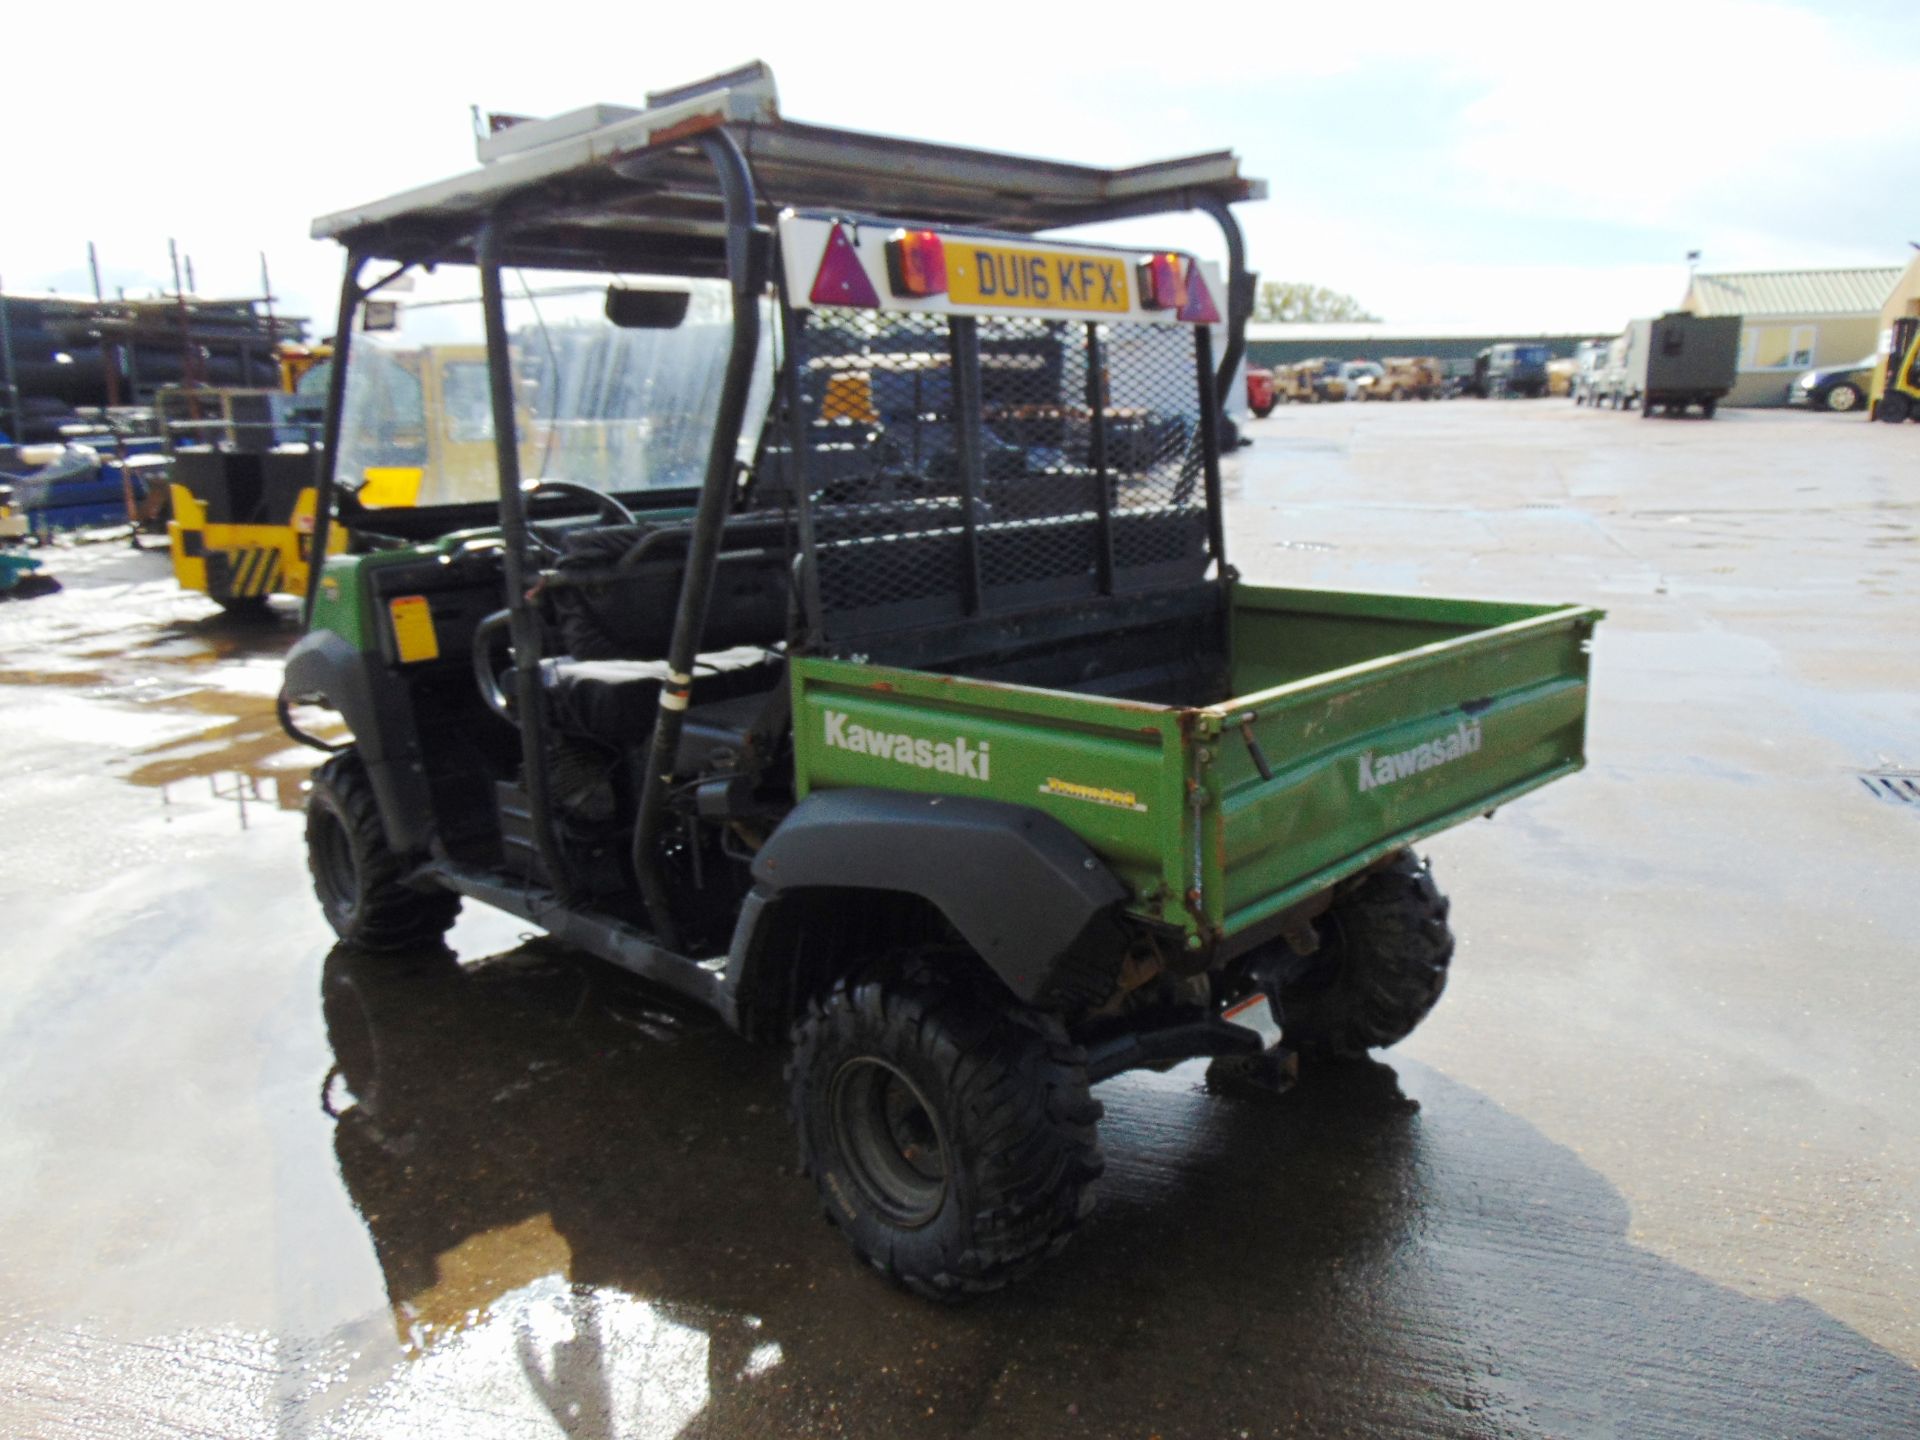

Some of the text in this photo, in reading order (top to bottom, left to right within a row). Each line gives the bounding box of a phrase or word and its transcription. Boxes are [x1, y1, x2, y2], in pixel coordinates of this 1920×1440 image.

[976, 251, 1118, 303] DU16 KFX
[824, 710, 990, 781] Kawasaki
[1358, 718, 1483, 792] Kawasaki
